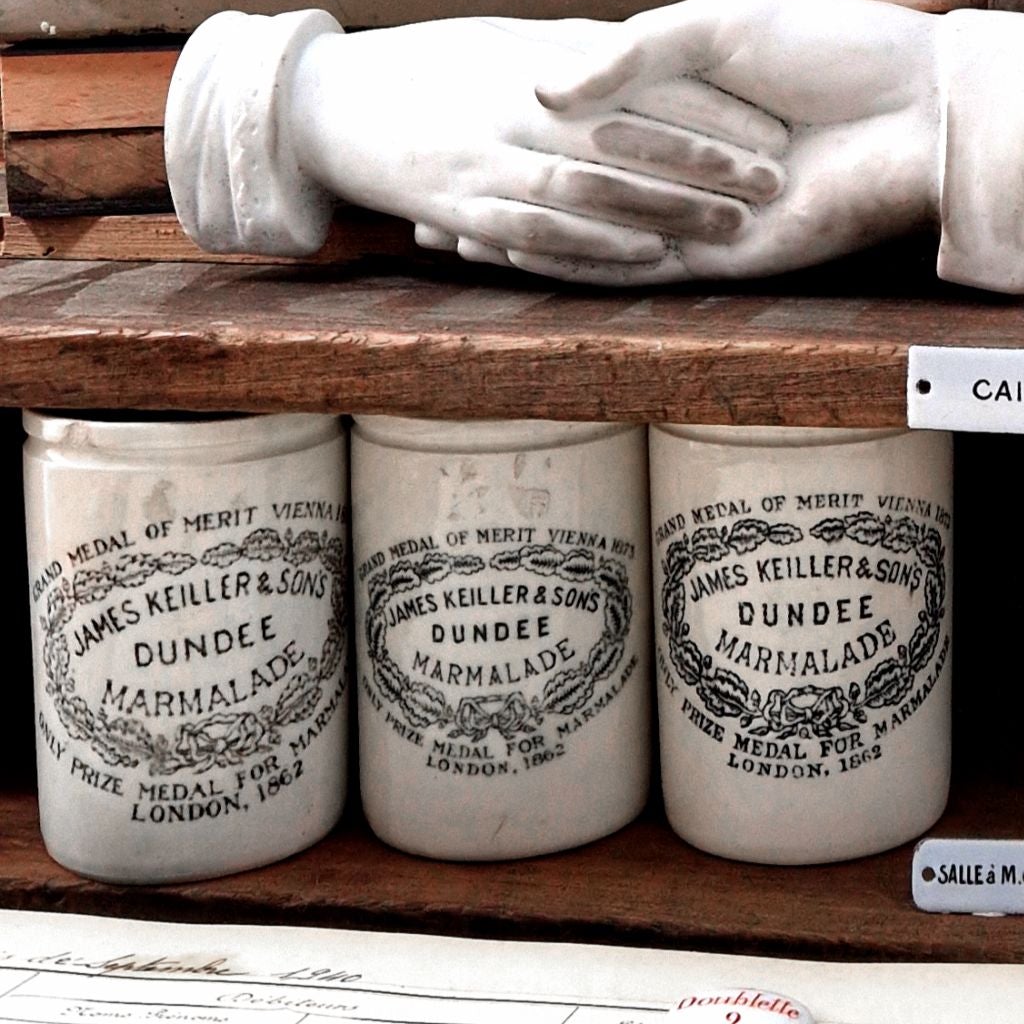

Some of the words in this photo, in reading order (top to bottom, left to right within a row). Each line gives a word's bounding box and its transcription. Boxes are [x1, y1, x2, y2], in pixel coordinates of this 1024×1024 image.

[691, 499, 752, 524] MEDAL
[761, 495, 786, 513] OF
[795, 493, 864, 511] MERIT
[877, 495, 932, 518] VIENNA
[67, 530, 136, 568] MEDAL
[145, 519, 173, 540] OF
[183, 505, 259, 533] MERIT
[272, 501, 334, 522] VIENNA
[389, 535, 439, 561] MEDAL
[446, 530, 467, 547] OF
[476, 527, 536, 544] MERIT
[549, 529, 607, 551] VIENNA
[690, 563, 749, 603] JAMES
[756, 554, 854, 583] KEILLER
[855, 556, 873, 580] &
[74, 599, 141, 658] JAMES
[145, 570, 251, 616] KEILLER
[388, 593, 439, 626] JAMES
[443, 584, 530, 610] KEILLER
[533, 585, 547, 605] &
[737, 594, 874, 628] DUNDEE
[134, 614, 277, 668] DUNDEE
[431, 615, 551, 644] DUNDEE
[714, 619, 897, 677] MARMALADE
[102, 639, 305, 718] MARMALADE
[411, 637, 577, 687] MARMALADE
[384, 712, 425, 748] PRIZE
[432, 739, 495, 760] MEDAL
[506, 736, 546, 757] FOR
[680, 697, 726, 743] PRIZE
[732, 733, 808, 761] MEDAL
[820, 732, 865, 759] FOR
[70, 756, 124, 796] PRIZE
[138, 779, 224, 802] MEDAL
[235, 755, 280, 790] FOR
[257, 759, 304, 802] 1862
[839, 745, 883, 773] 1862
[938, 863, 984, 886] SALLE
[985, 863, 996, 885] à
[1001, 864, 1022, 886] M.
